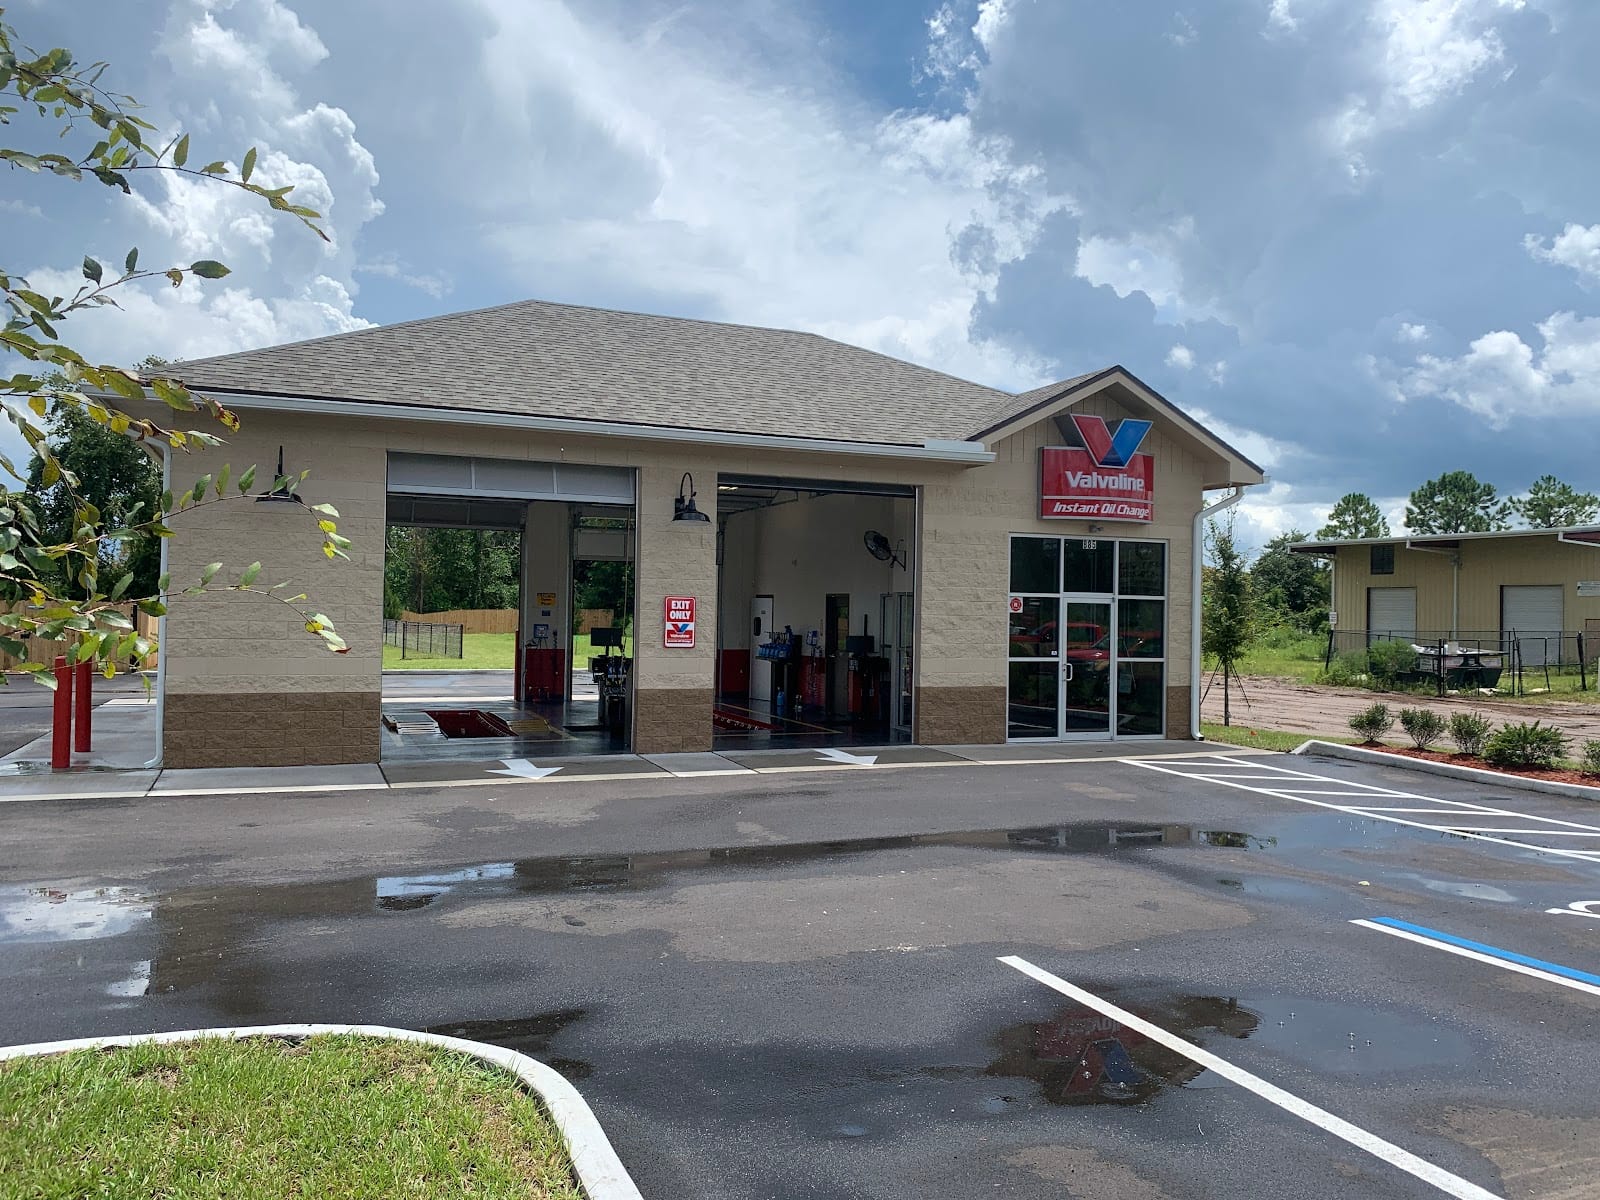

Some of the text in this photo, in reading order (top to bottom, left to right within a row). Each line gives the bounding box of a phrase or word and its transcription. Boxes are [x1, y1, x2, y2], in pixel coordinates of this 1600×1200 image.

[1065, 471, 1145, 492] Valvoline
[1053, 502, 1149, 518] Instant Oil Change
[672, 601, 690, 609] EXIT
[670, 611, 691, 619] ONLY
